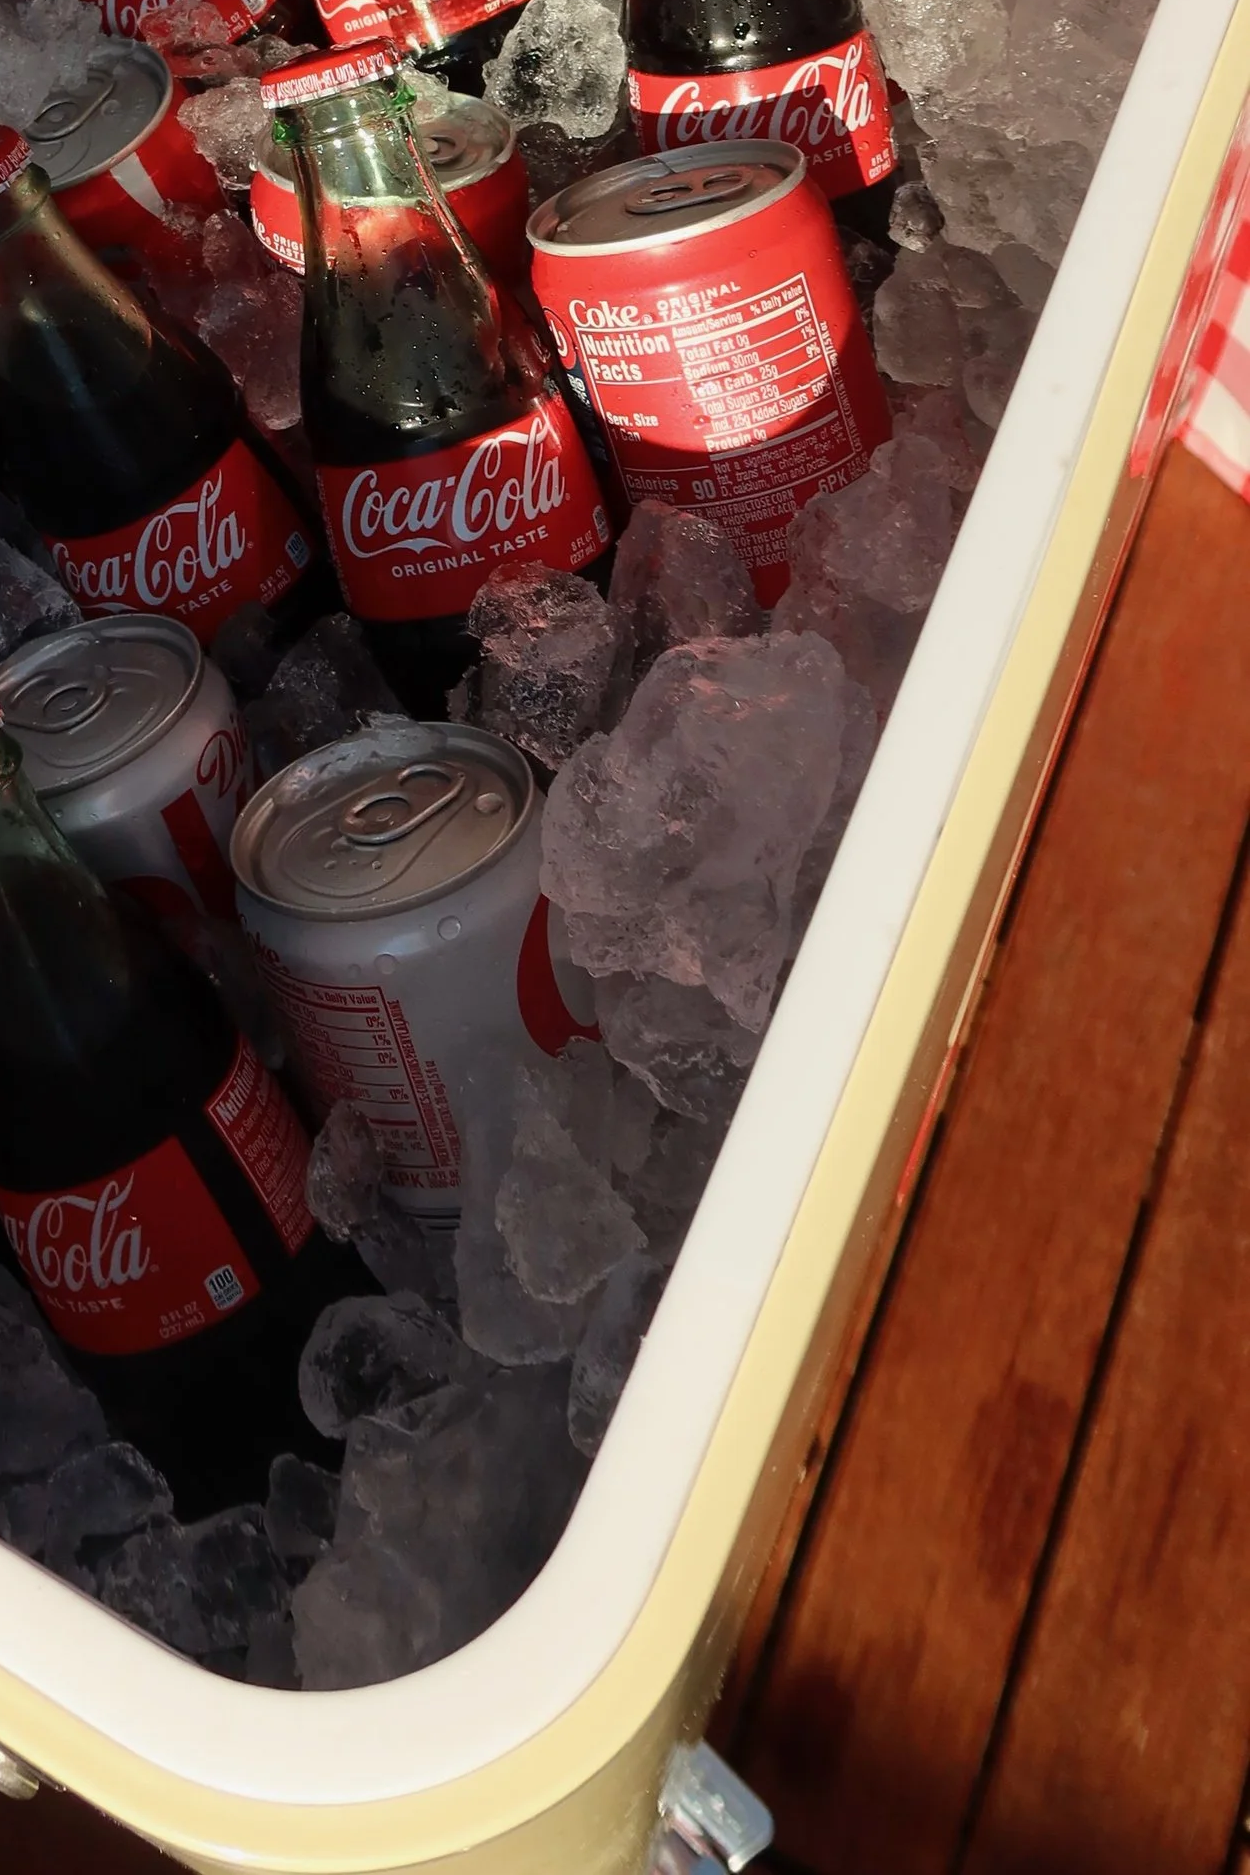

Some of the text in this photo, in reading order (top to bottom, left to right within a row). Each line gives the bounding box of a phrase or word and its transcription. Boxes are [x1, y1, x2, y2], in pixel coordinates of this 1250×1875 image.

[344, 3, 408, 33] ORIGINAL
[656, 38, 873, 153] Coca-Cola
[273, 233, 304, 253] ORIGI
[656, 281, 742, 312] ORIGINAL
[749, 303, 761, 316] %
[760, 295, 782, 312] Daily
[781, 284, 803, 302] Value
[568, 299, 640, 328] Coke
[657, 300, 716, 322] TASTE
[581, 332, 671, 359] Nutrition
[677, 305, 810, 363] Total Fat 0g 0%
[682, 323, 816, 381] Sodium 30mg 1%
[589, 360, 643, 383] Facts
[689, 342, 821, 400] Total Carb. 25g 9%
[700, 384, 780, 417] Total Sugars 25g
[732, 413, 750, 429] 25g
[750, 405, 780, 424] Added
[779, 392, 809, 413] Sugars
[811, 378, 833, 398] 50%
[605, 411, 659, 427] Serv. Size
[620, 428, 641, 443] Can
[705, 428, 767, 453] Protein 0g
[713, 461, 731, 475] Not
[742, 446, 789, 468] significant
[342, 416, 566, 559] Coca-Cola
[625, 474, 717, 501] Calories 90
[735, 468, 759, 482] trans
[770, 472, 790, 486] iron
[817, 468, 848, 494] 6PK
[705, 488, 796, 518] HIGH FRUCTOSE CORN
[722, 508, 778, 526] PHOSPHORIC
[52, 468, 246, 613] Coca-Cola
[391, 524, 550, 579] ORIGINAL TASTE
[577, 537, 587, 550] FL
[750, 531, 770, 545] THE
[175, 578, 234, 617] TASTE
[324, 992, 348, 1006] Daily
[349, 994, 377, 1005] Value
[365, 1015, 386, 1029] 0%
[372, 1033, 392, 1047] 1%
[377, 1051, 398, 1065] 0%
[214, 1061, 255, 1127] Nutrition
[389, 1088, 410, 1101] 0%
[3, 1171, 151, 1293] a-Cola
[208, 1267, 234, 1294] 100
[66, 1296, 126, 1315] TASTE
[169, 1308, 183, 1322] FL
[158, 1323, 184, 1340] (237
